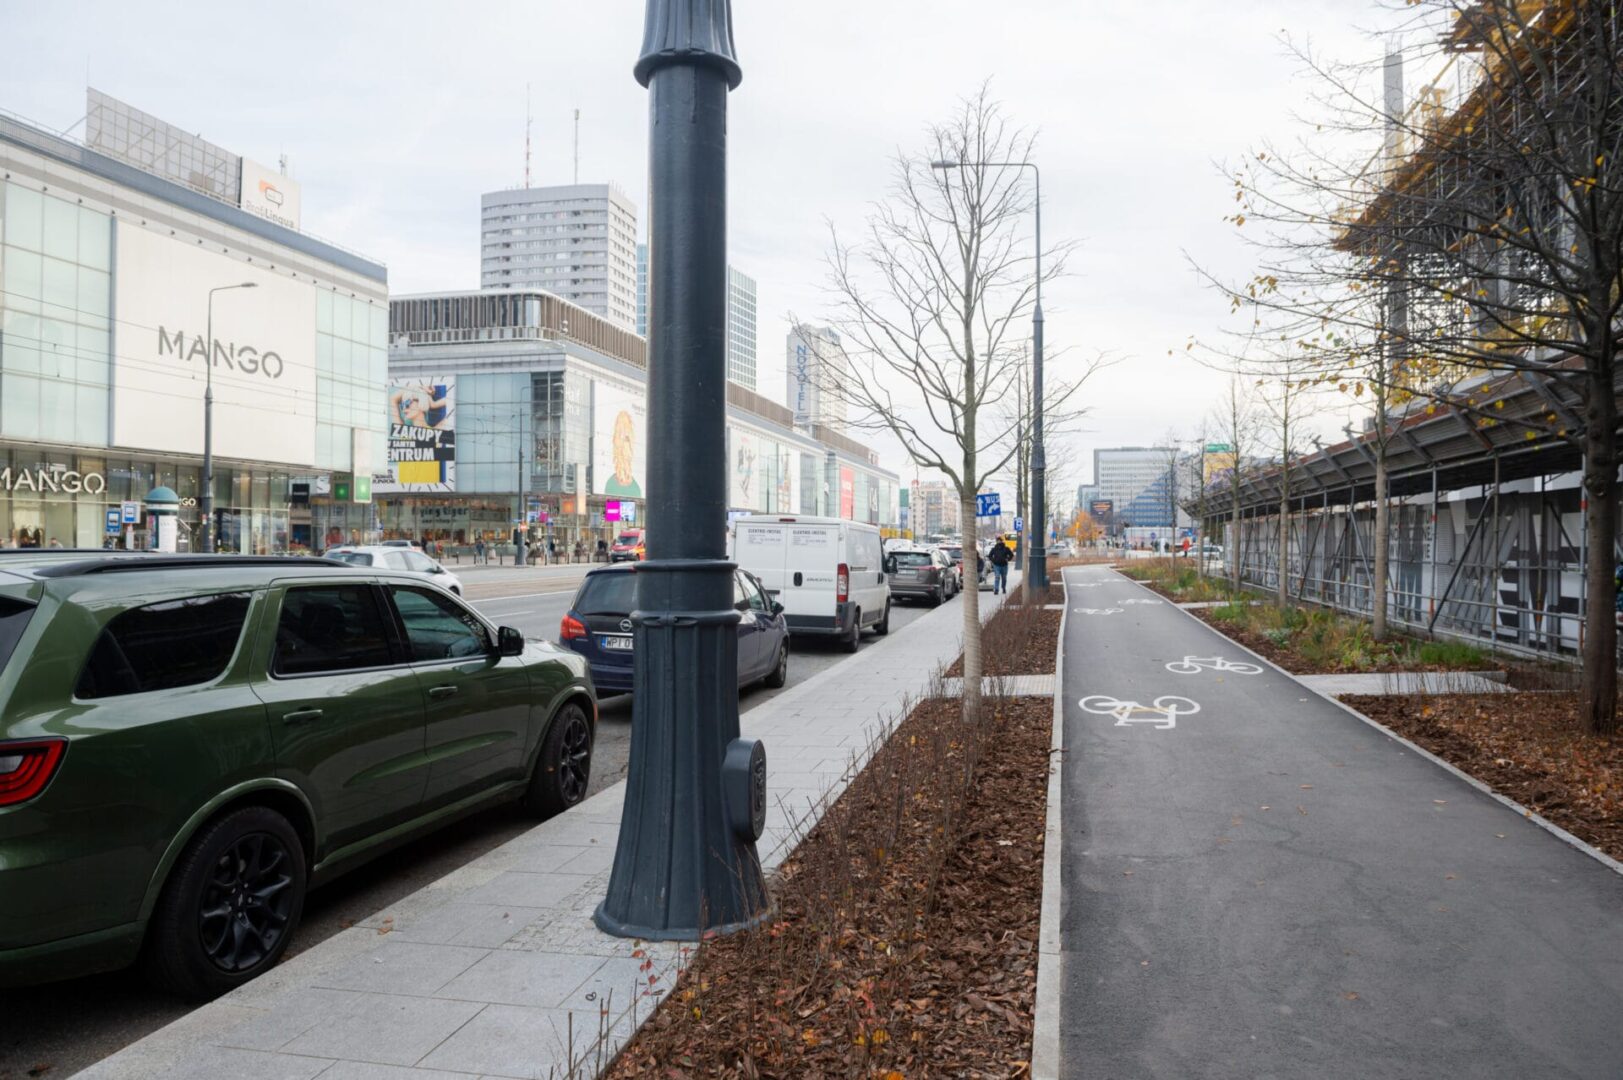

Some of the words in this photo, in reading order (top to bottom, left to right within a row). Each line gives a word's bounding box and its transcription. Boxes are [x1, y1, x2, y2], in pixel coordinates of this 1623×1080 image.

[158, 325, 283, 379] MANGO
[796, 344, 808, 412] NOVOTEL
[392, 424, 443, 446] ZAKUPY
[387, 447, 435, 461] ENTRUM
[984, 495, 1000, 503] BUS
